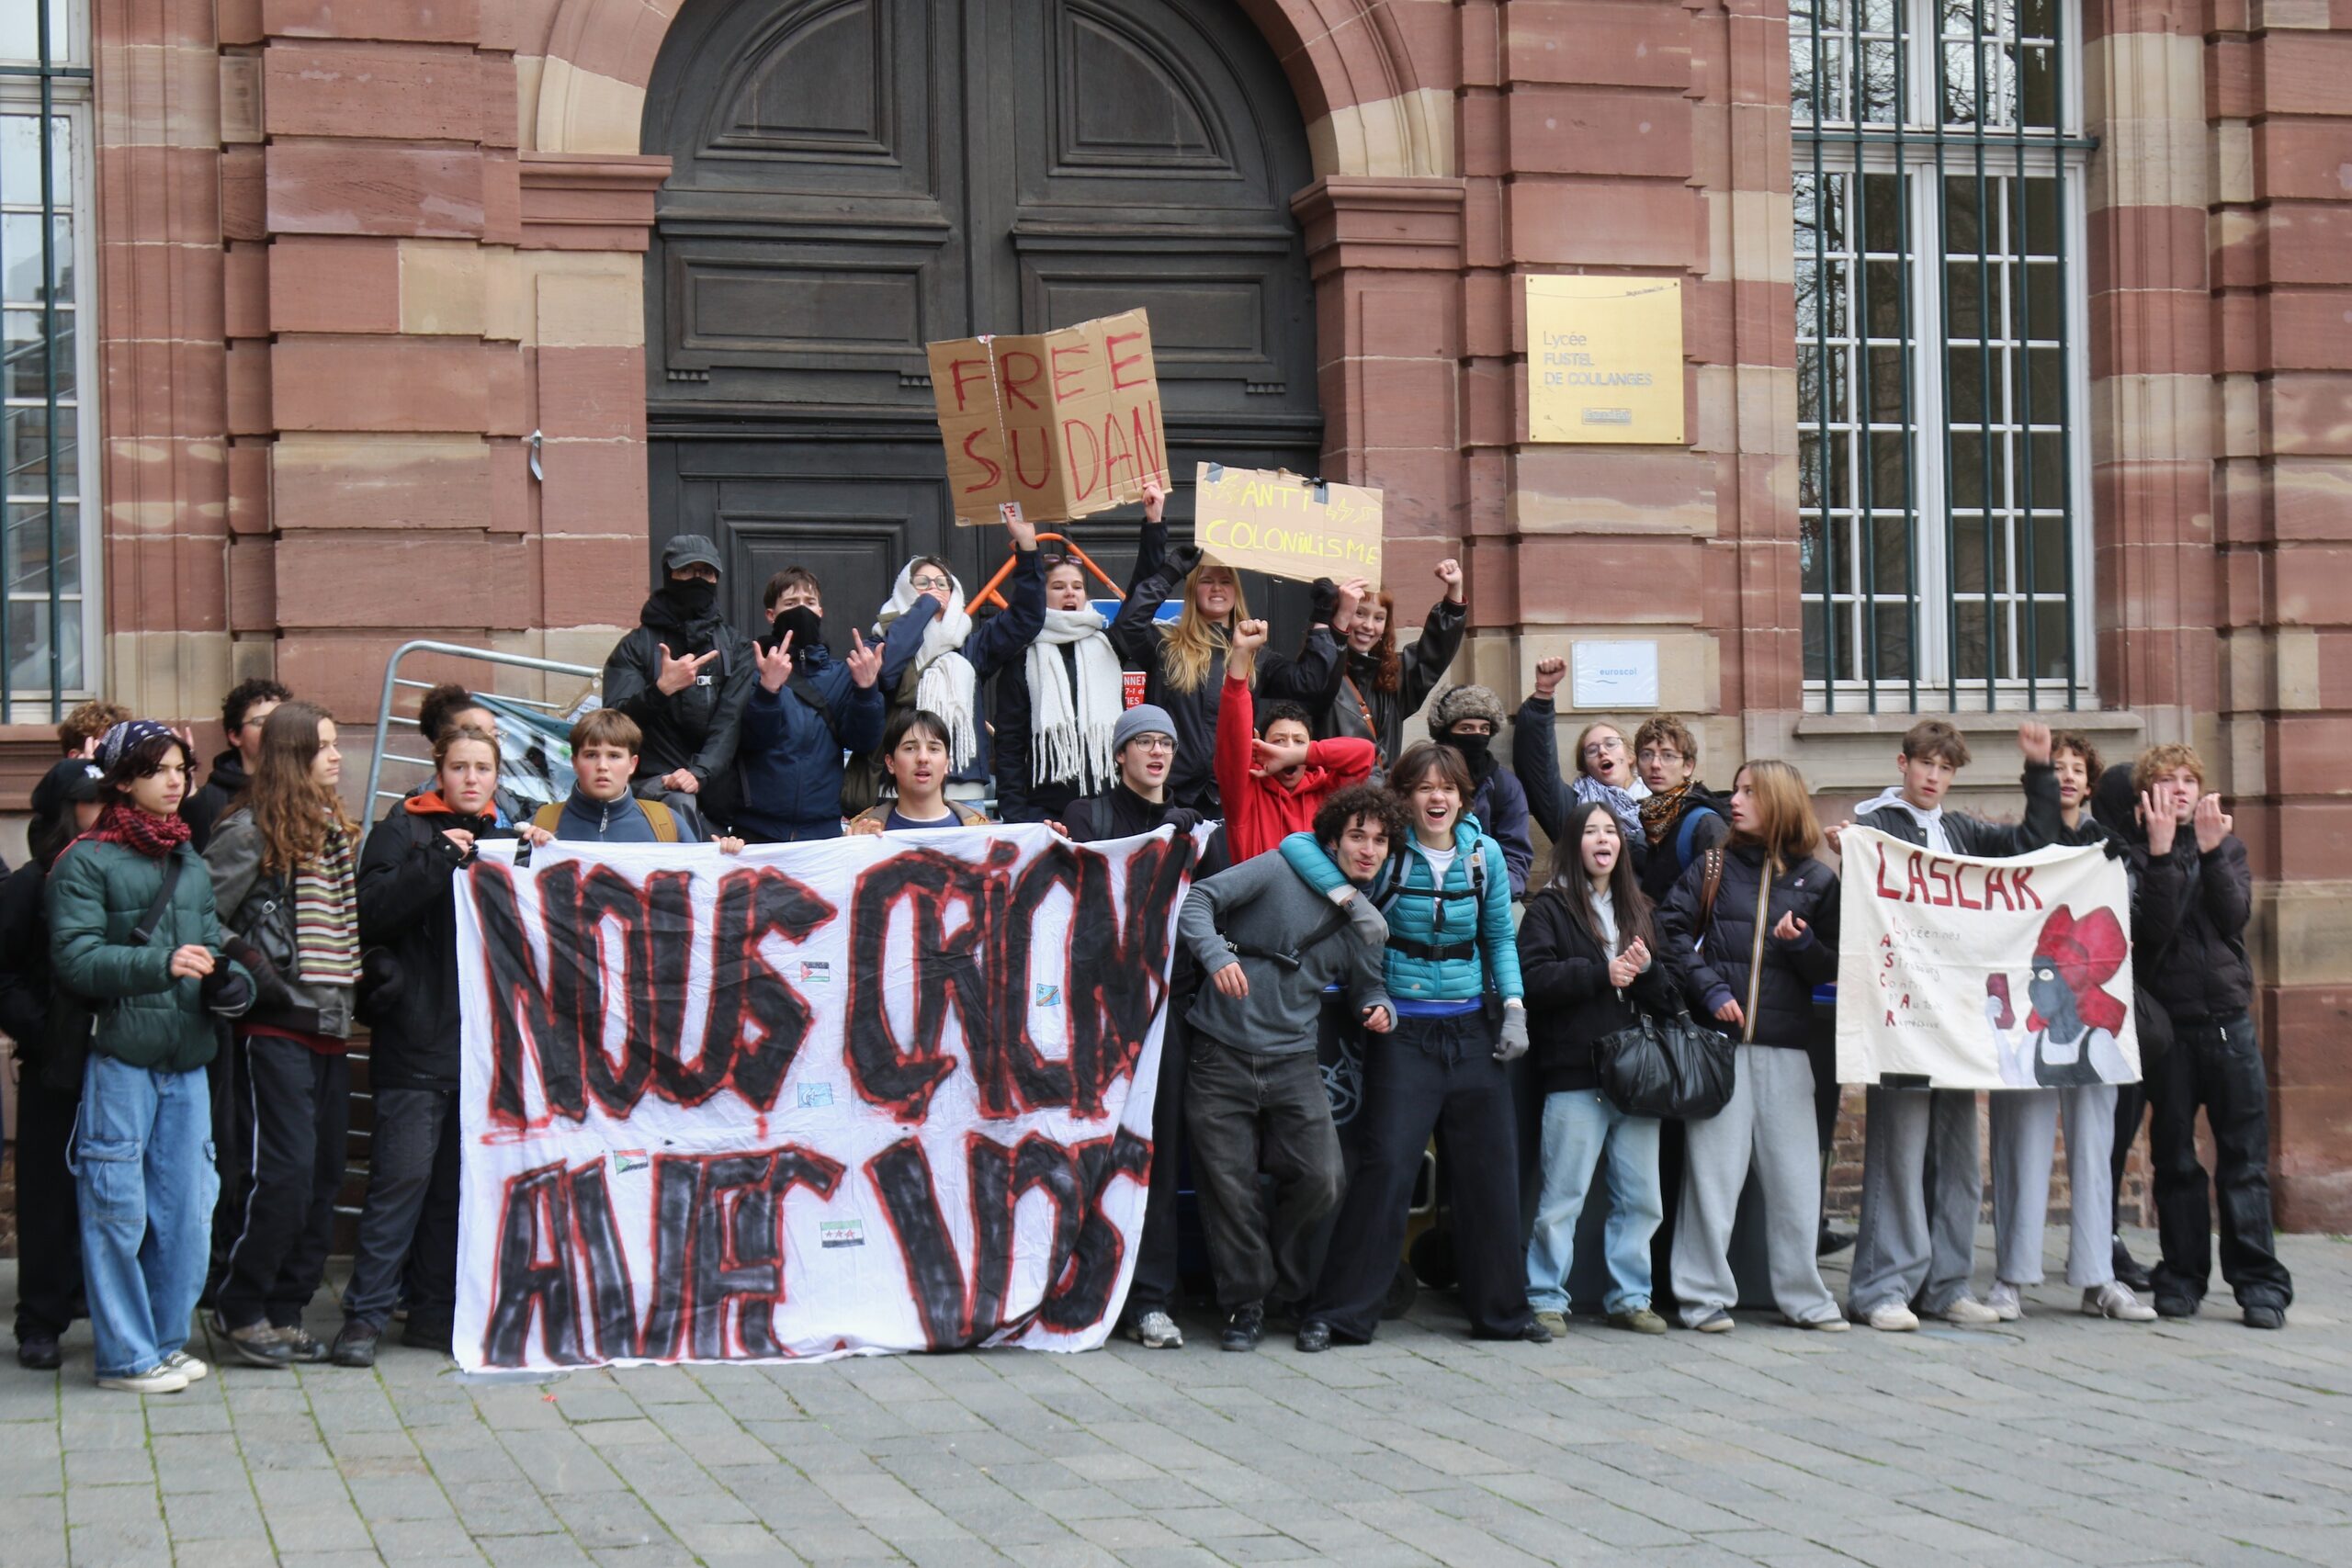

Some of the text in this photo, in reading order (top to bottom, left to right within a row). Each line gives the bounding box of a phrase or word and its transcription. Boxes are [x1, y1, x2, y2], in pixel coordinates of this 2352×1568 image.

[949, 332, 1149, 412] FREE
[1544, 331, 1587, 348] Lycée
[1544, 352, 1595, 367] FUSTEL
[1544, 372, 1653, 386] DE COULANGES
[963, 399, 1167, 501] SUDAN
[1600, 667, 1637, 676] euroscol
[1876, 841, 2043, 911] LASCAR
[469, 859, 838, 1130] NOUS
[862, 1122, 1153, 1351] VOS
